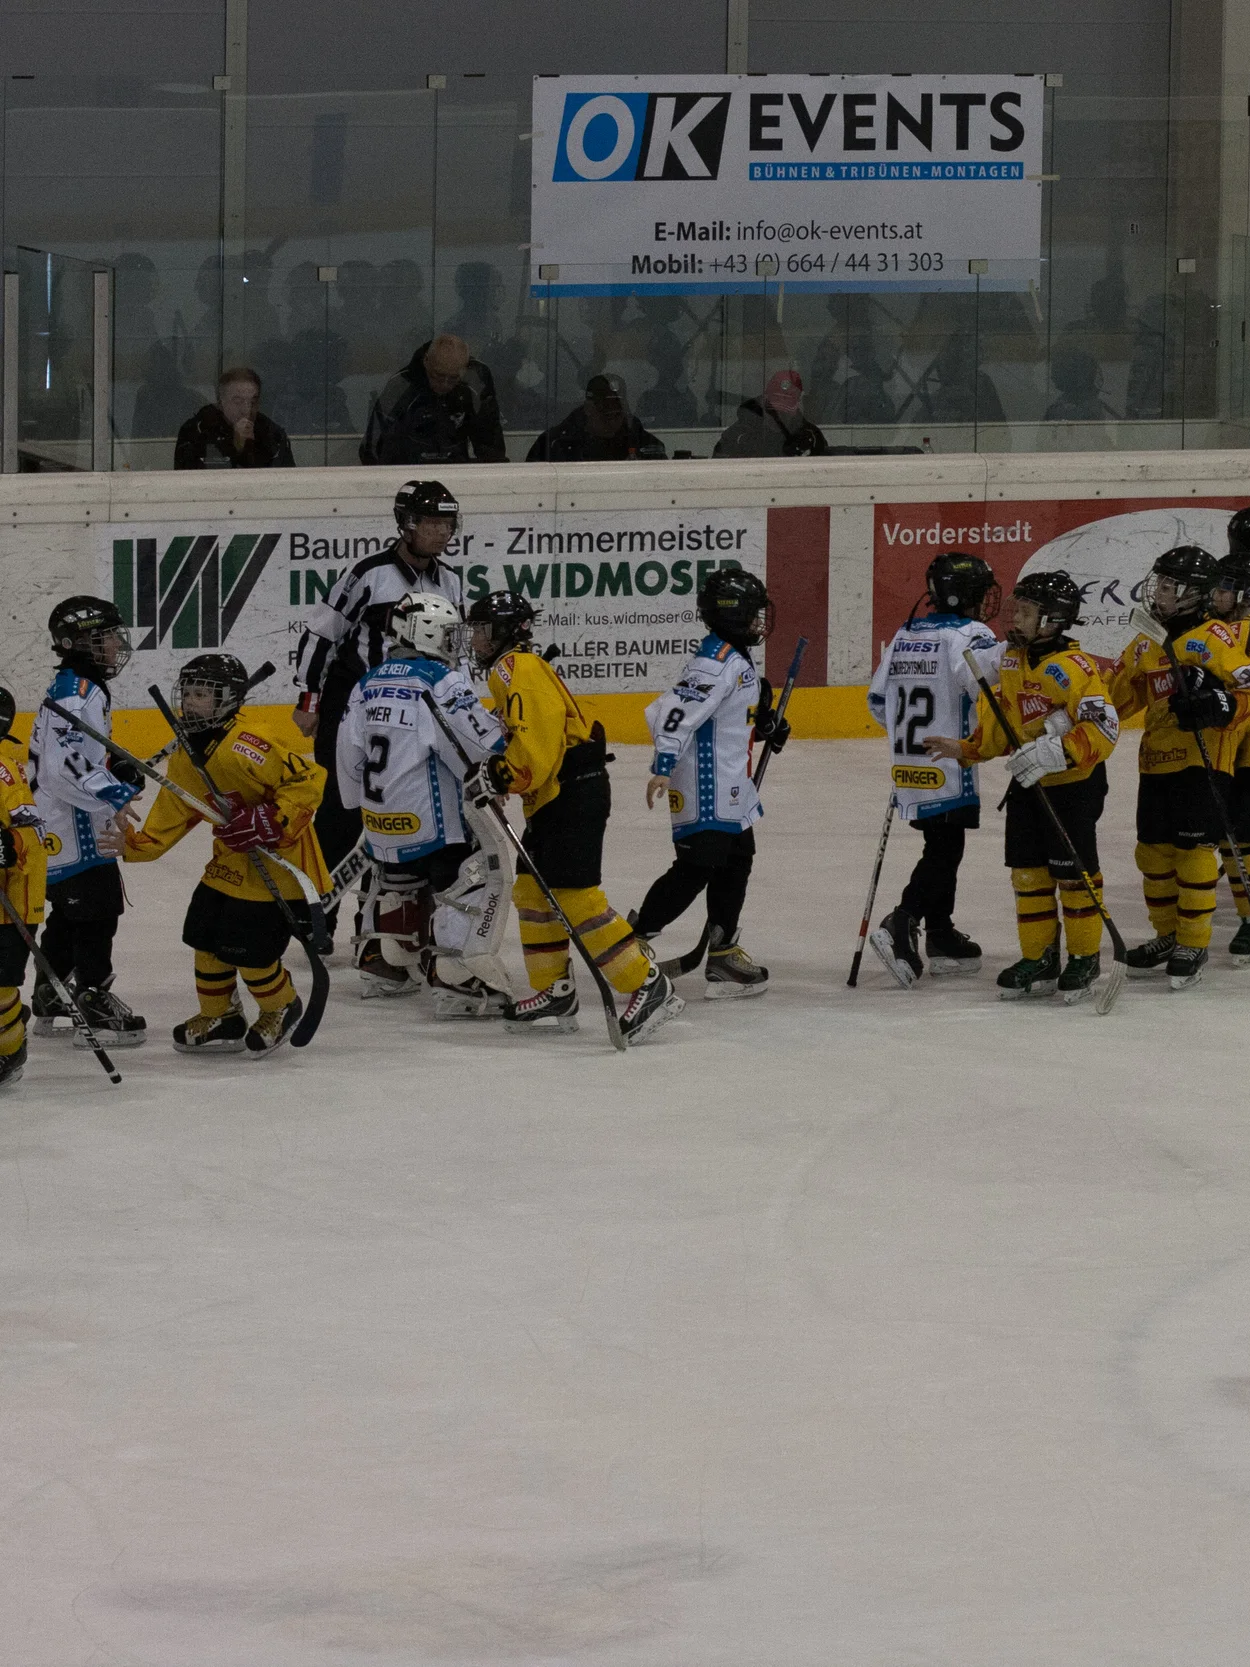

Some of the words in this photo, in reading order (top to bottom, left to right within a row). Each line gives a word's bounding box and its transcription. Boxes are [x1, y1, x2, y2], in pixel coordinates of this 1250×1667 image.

[565, 94, 723, 180] OK
[749, 91, 1025, 153] EVENTS
[753, 163, 821, 179] BÜHNEN
[825, 166, 835, 178] &
[840, 163, 1020, 179] TRIBÜNEN-MONTAGEN
[655, 221, 731, 242] E-Mail:
[737, 220, 923, 244] info@ok-events.at
[631, 254, 703, 275] Mobil:
[709, 256, 747, 274] +43
[787, 255, 826, 274] 664
[830, 254, 839, 273] /
[845, 254, 871, 273] 44
[877, 254, 899, 273] 31
[908, 253, 944, 273] 303
[291, 533, 474, 560] Baumeer
[507, 524, 747, 555] Zimmermeister
[883, 520, 1032, 546] Vorderstadt
[615, 638, 703, 656] BAUMEIS
[468, 714, 488, 737] 2
[663, 707, 685, 733] 8
[233, 743, 265, 765] RICOH
[362, 735, 389, 803] 2
[895, 769, 938, 785] FINGER
[477, 893, 499, 938] Reebok
